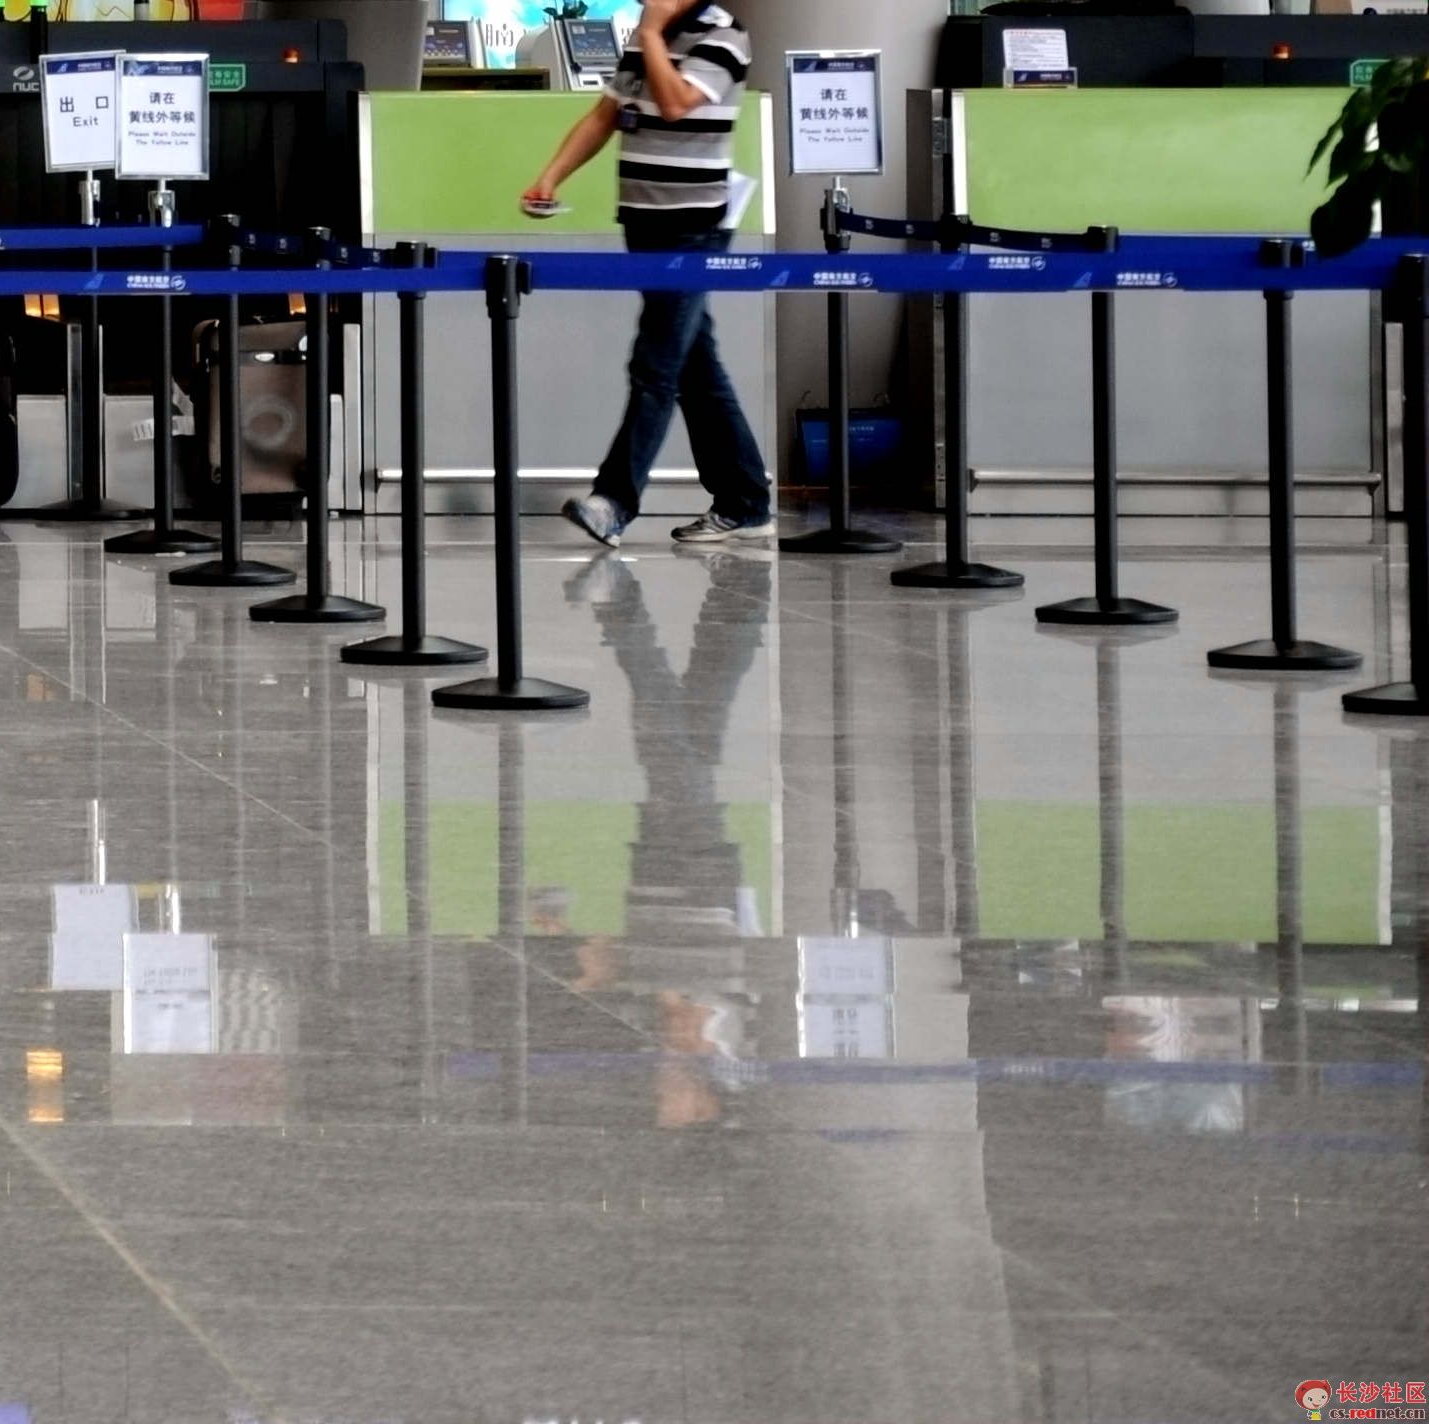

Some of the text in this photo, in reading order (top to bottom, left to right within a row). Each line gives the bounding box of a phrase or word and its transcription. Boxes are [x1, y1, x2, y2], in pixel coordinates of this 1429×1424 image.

[150, 92, 174, 104] 请在
[821, 89, 845, 100] 请在
[60, 96, 109, 112] 出口
[130, 111, 194, 123] 黄线外等候
[800, 107, 868, 120] 黄线外等候
[73, 117, 98, 127] Exit
